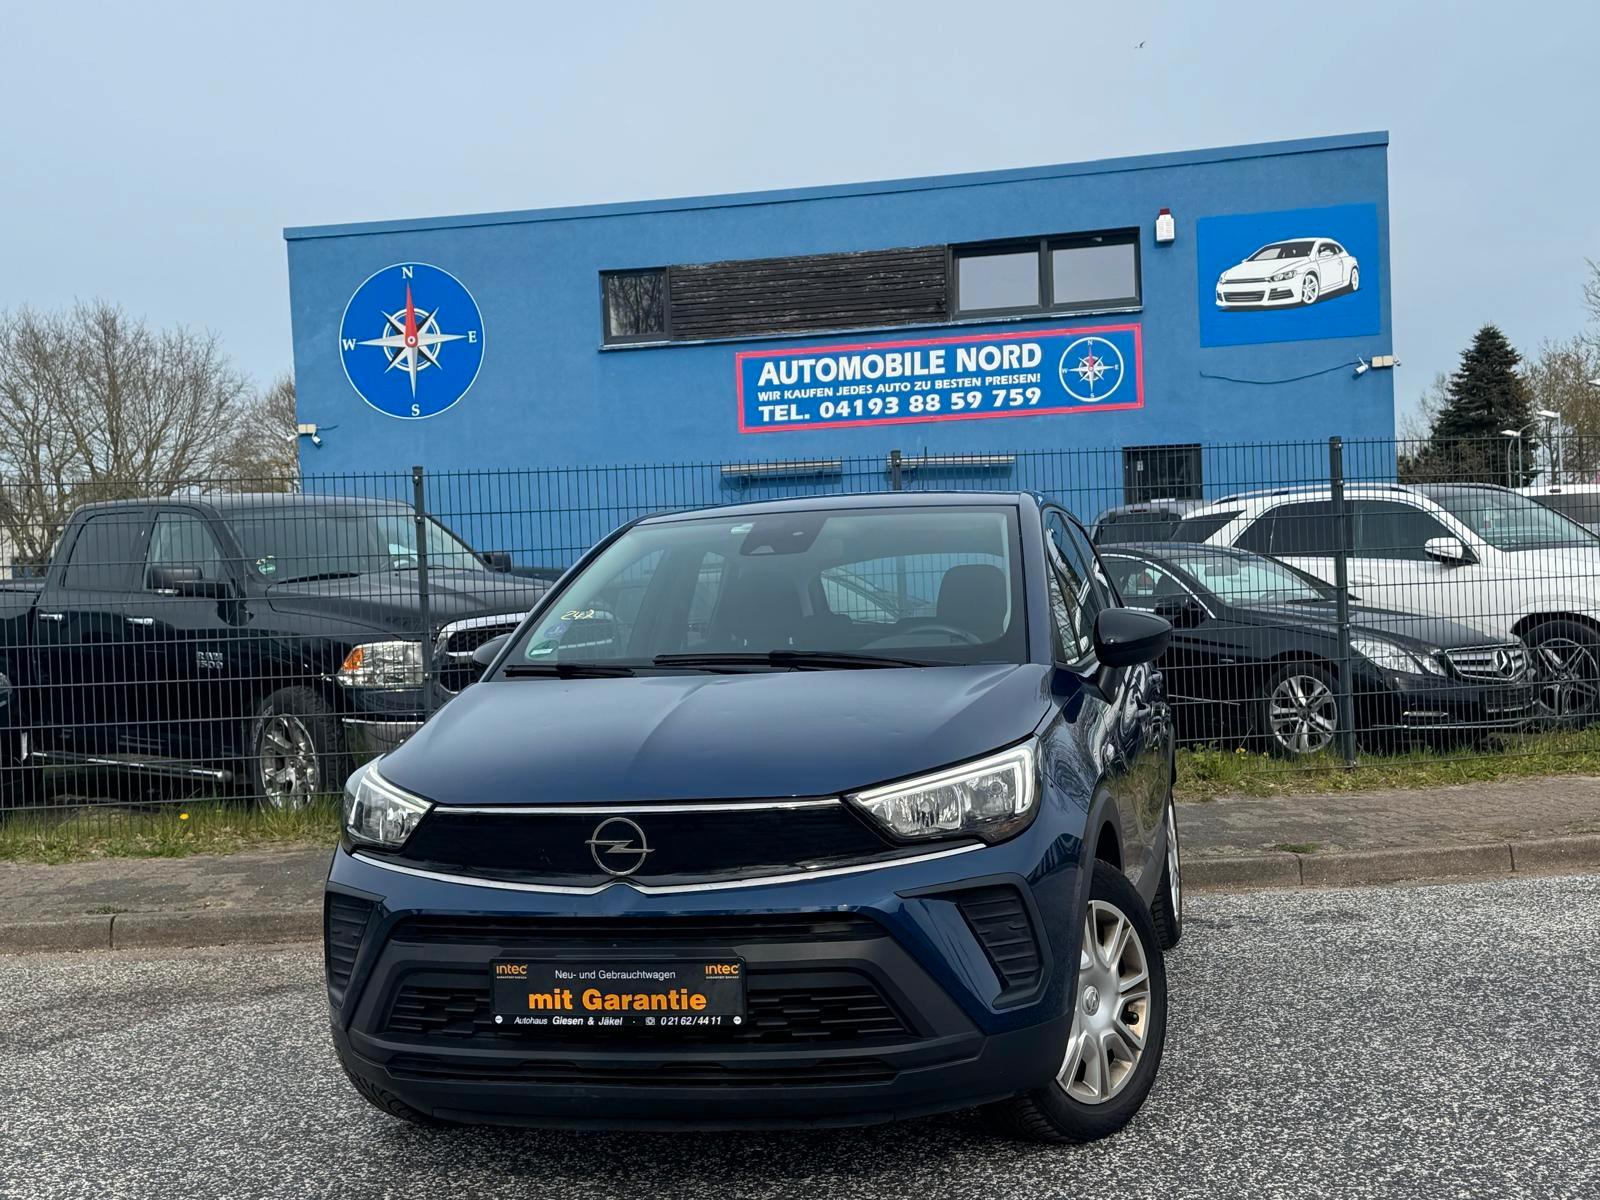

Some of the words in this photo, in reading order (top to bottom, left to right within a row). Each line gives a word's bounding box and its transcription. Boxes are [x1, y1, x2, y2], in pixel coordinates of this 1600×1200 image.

[402, 266, 413, 279] N
[468, 331, 477, 343] E
[343, 338, 356, 351] W
[758, 350, 946, 386] AUTOMOBILE
[956, 343, 1042, 373] NORD
[758, 391, 781, 401] WIR
[783, 387, 833, 399] KAUFEN
[836, 384, 872, 396] JEDES
[876, 382, 911, 393] AUTO
[914, 381, 931, 390] ZU
[935, 377, 981, 389] BESTEN
[985, 373, 1041, 385] PREISEN!
[411, 404, 420, 416] S
[758, 404, 810, 422] TEL.
[819, 396, 899, 418] 04193
[909, 393, 941, 413] 88
[950, 390, 982, 410] 59
[992, 387, 1041, 407] 759
[496, 964, 529, 975] intec
[555, 970, 577, 979] Neu-
[579, 970, 596, 979] und
[598, 969, 676, 981] Gebrauchtwagen
[705, 964, 740, 975] intec
[528, 988, 573, 1010] mit
[582, 988, 707, 1011] Garantie
[514, 1017, 548, 1025] Autohaus
[552, 1016, 584, 1025] Giesen
[588, 1017, 594, 1025] &
[598, 1016, 623, 1026] Jäkel
